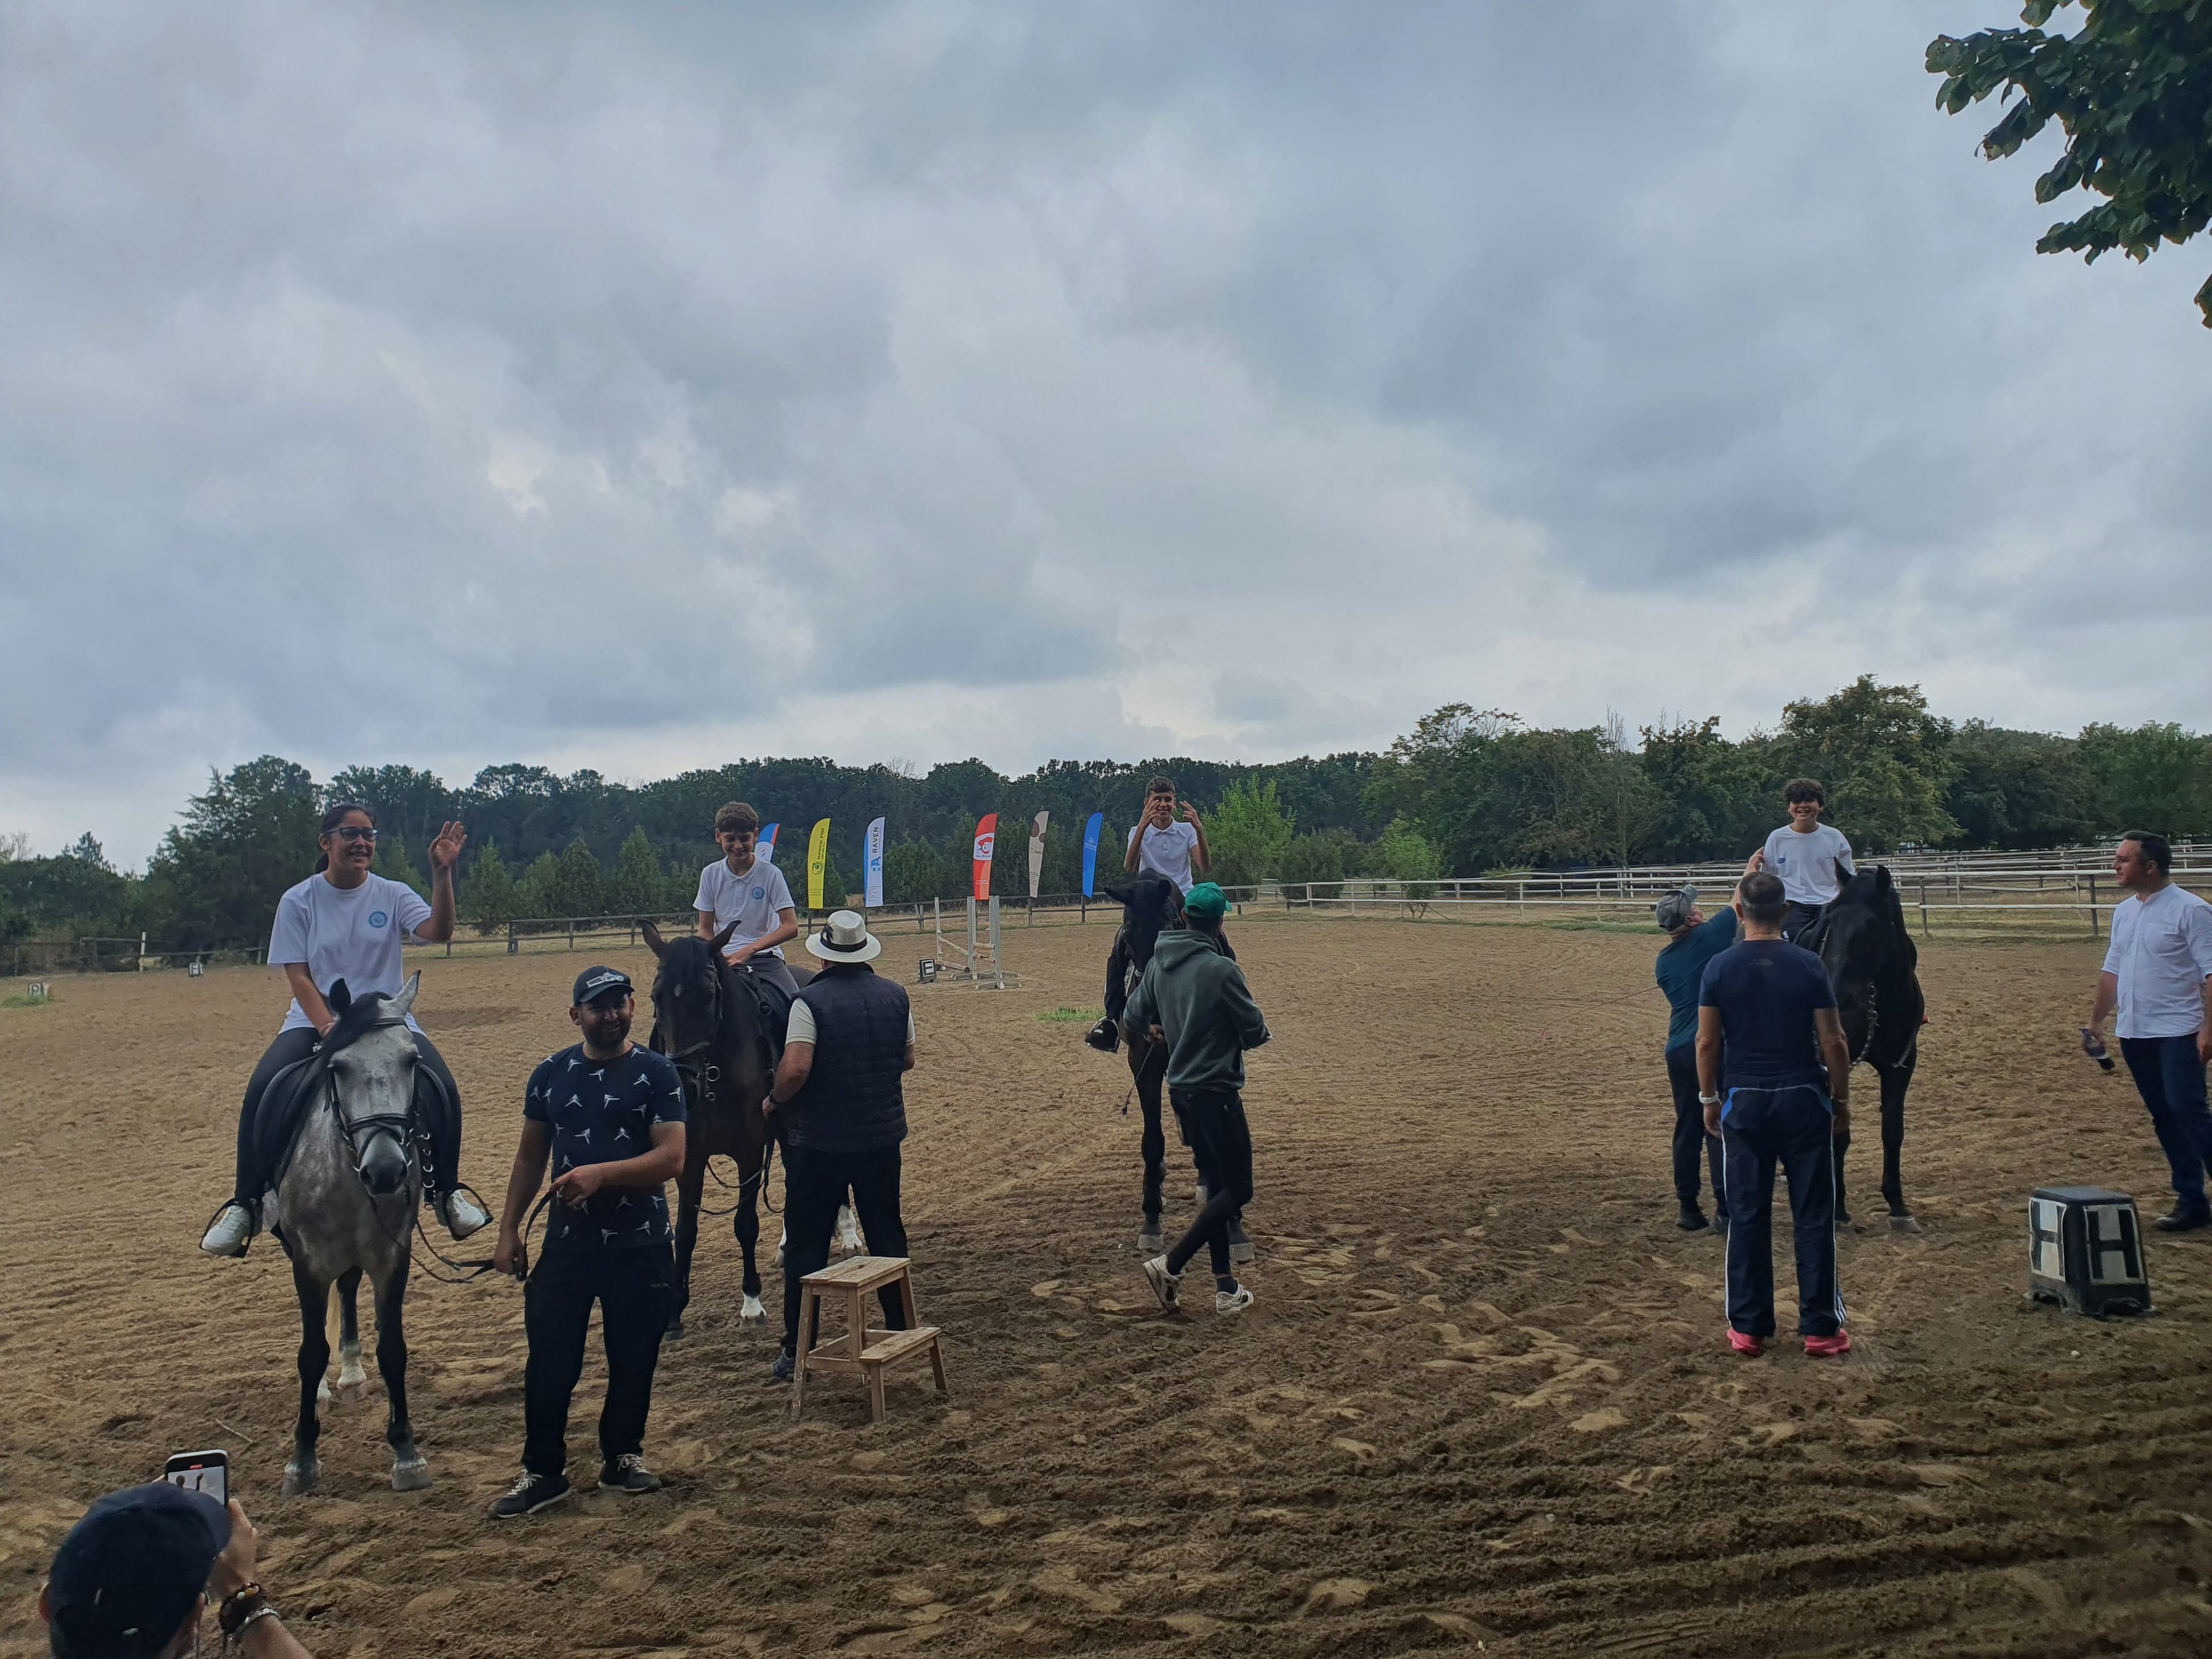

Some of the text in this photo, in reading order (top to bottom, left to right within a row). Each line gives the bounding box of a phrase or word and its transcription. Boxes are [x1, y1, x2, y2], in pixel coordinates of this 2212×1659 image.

[922, 961, 935, 976] E
[2032, 1200, 2065, 1277] H
[2086, 1209, 2141, 1279] H
